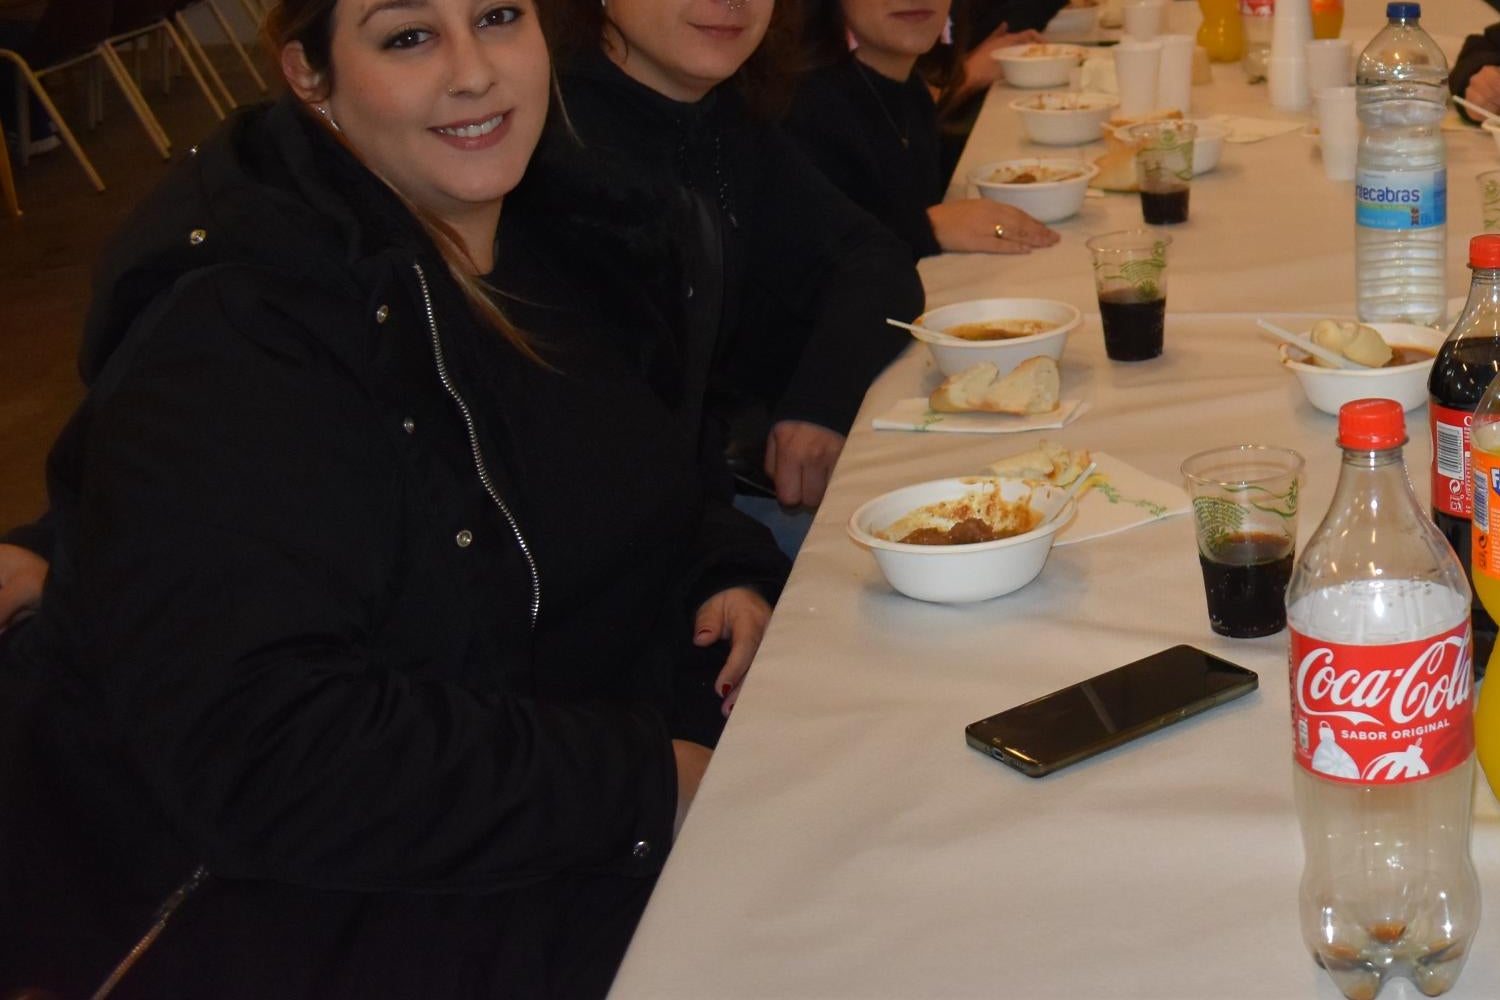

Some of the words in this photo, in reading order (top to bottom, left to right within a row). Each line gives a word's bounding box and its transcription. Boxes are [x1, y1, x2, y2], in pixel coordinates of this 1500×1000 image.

[1356, 184, 1420, 203] ntecabras
[1297, 624, 1472, 725] Coca-Cola
[1341, 729, 1387, 740] SABOR
[1392, 719, 1450, 740] ORIGINAL
